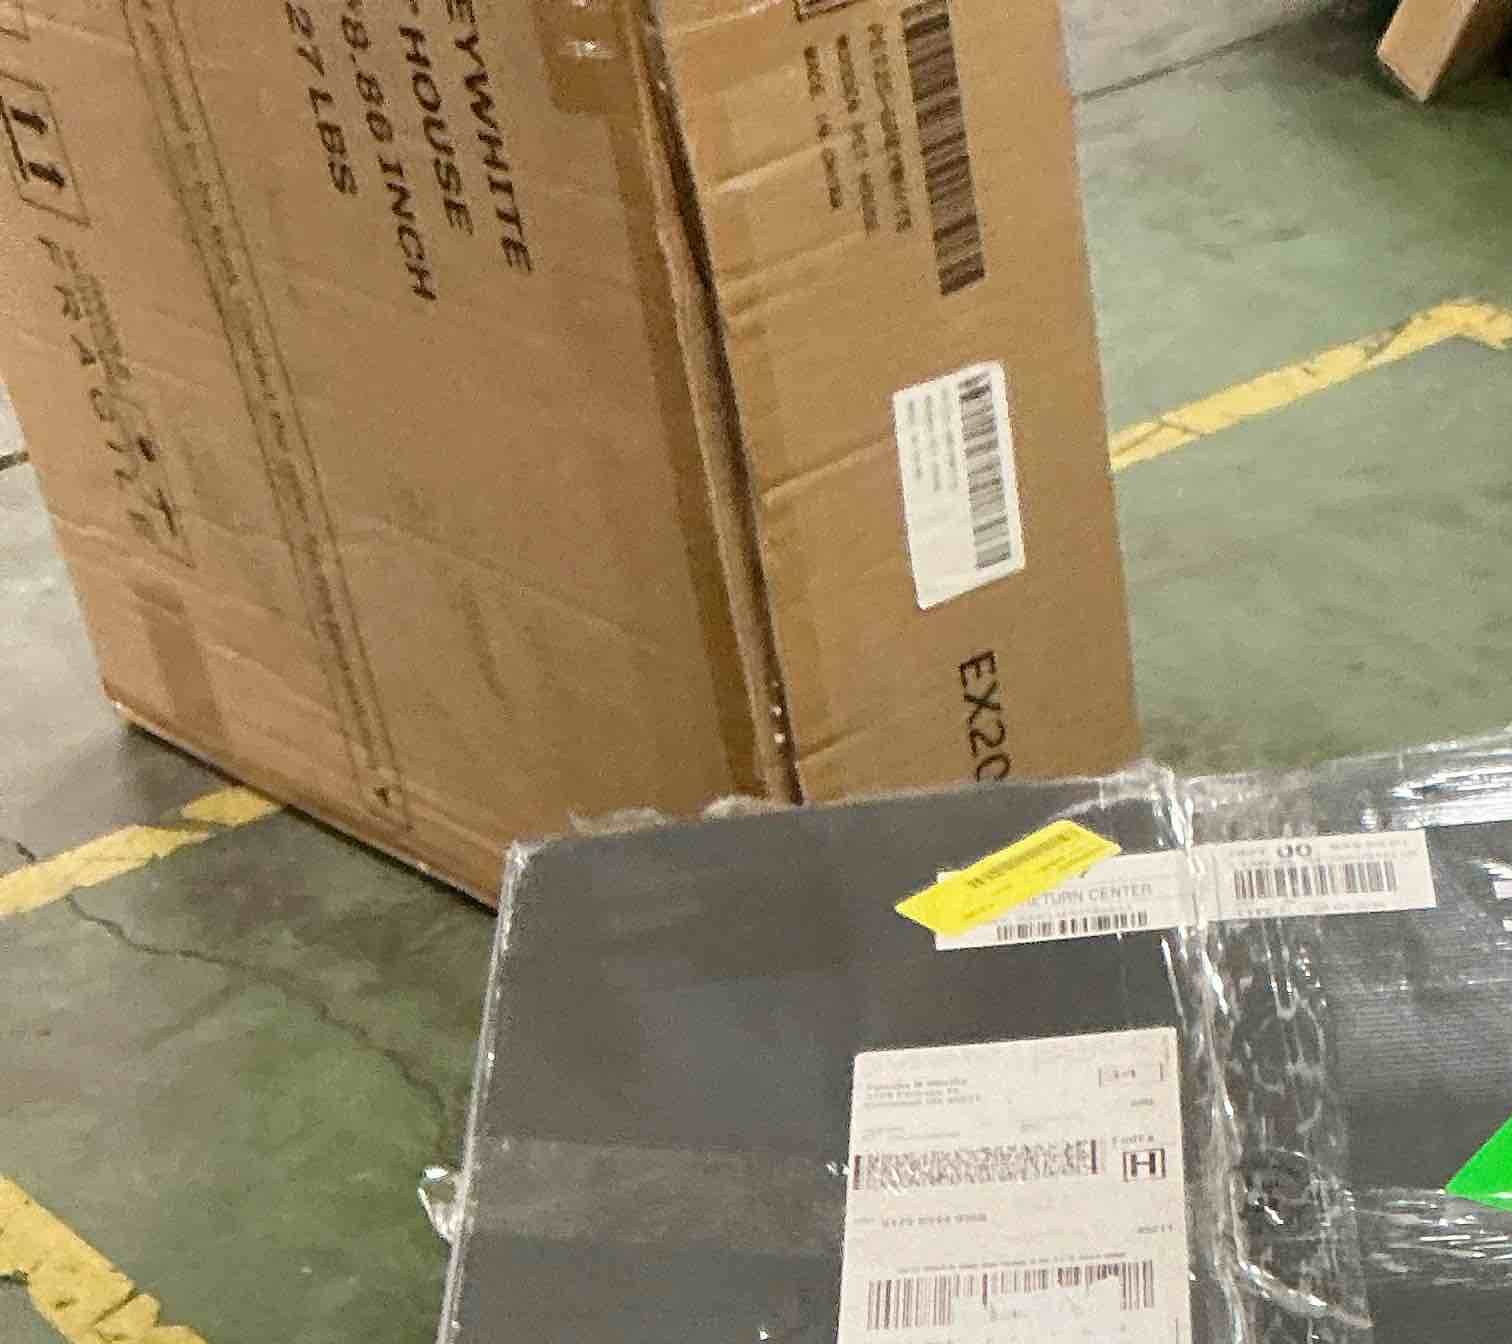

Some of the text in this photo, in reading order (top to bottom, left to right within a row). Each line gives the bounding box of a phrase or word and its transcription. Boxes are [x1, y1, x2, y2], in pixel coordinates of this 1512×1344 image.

[308, 86, 358, 195] LBS
[399, 24, 475, 236] HOUSE
[376, 153, 437, 301] INCH
[1028, 883, 1153, 906] ETURN CENTER
